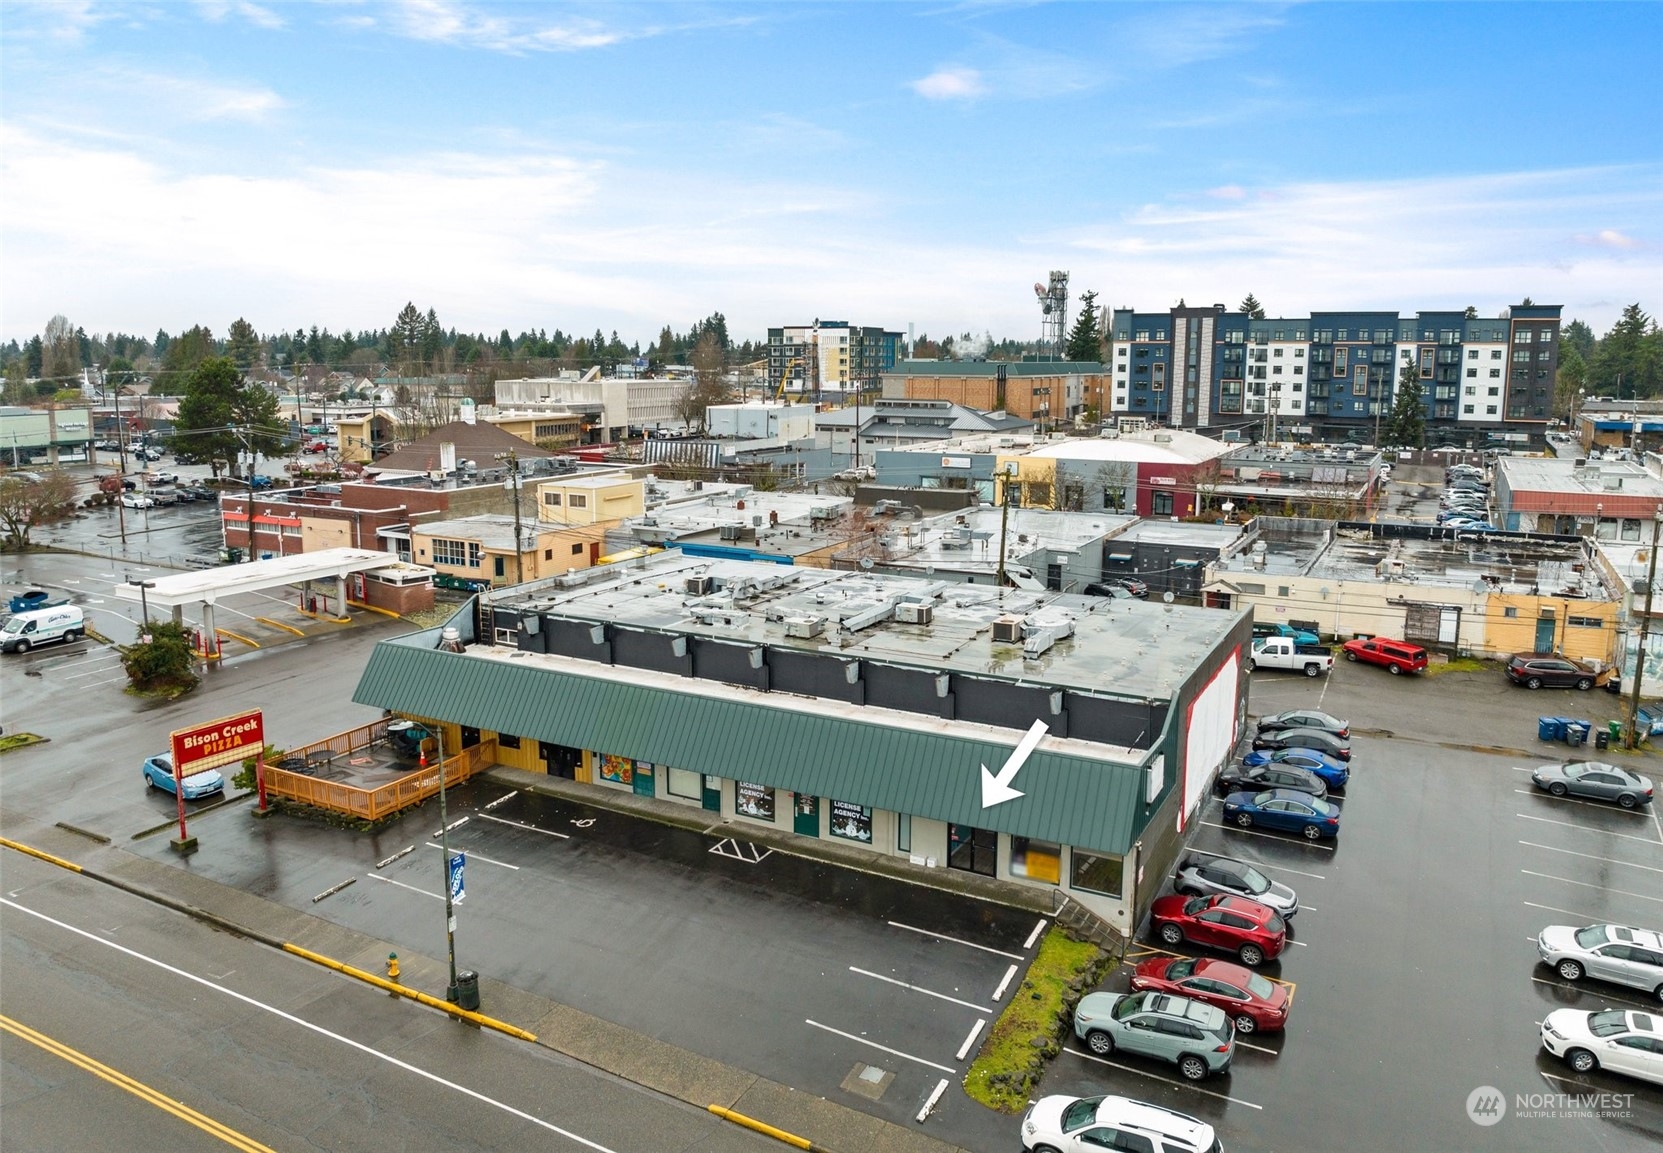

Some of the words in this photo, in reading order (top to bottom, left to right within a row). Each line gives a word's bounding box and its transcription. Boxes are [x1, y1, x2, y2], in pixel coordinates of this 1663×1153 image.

[183, 732, 219, 749] Bison
[222, 719, 258, 737] Creek
[203, 735, 243, 755] PIZZA
[739, 781, 765, 791] LICENSE
[739, 788, 765, 798] AGENCY
[833, 800, 861, 811] LICENSE
[833, 808, 860, 819] AGENCY
